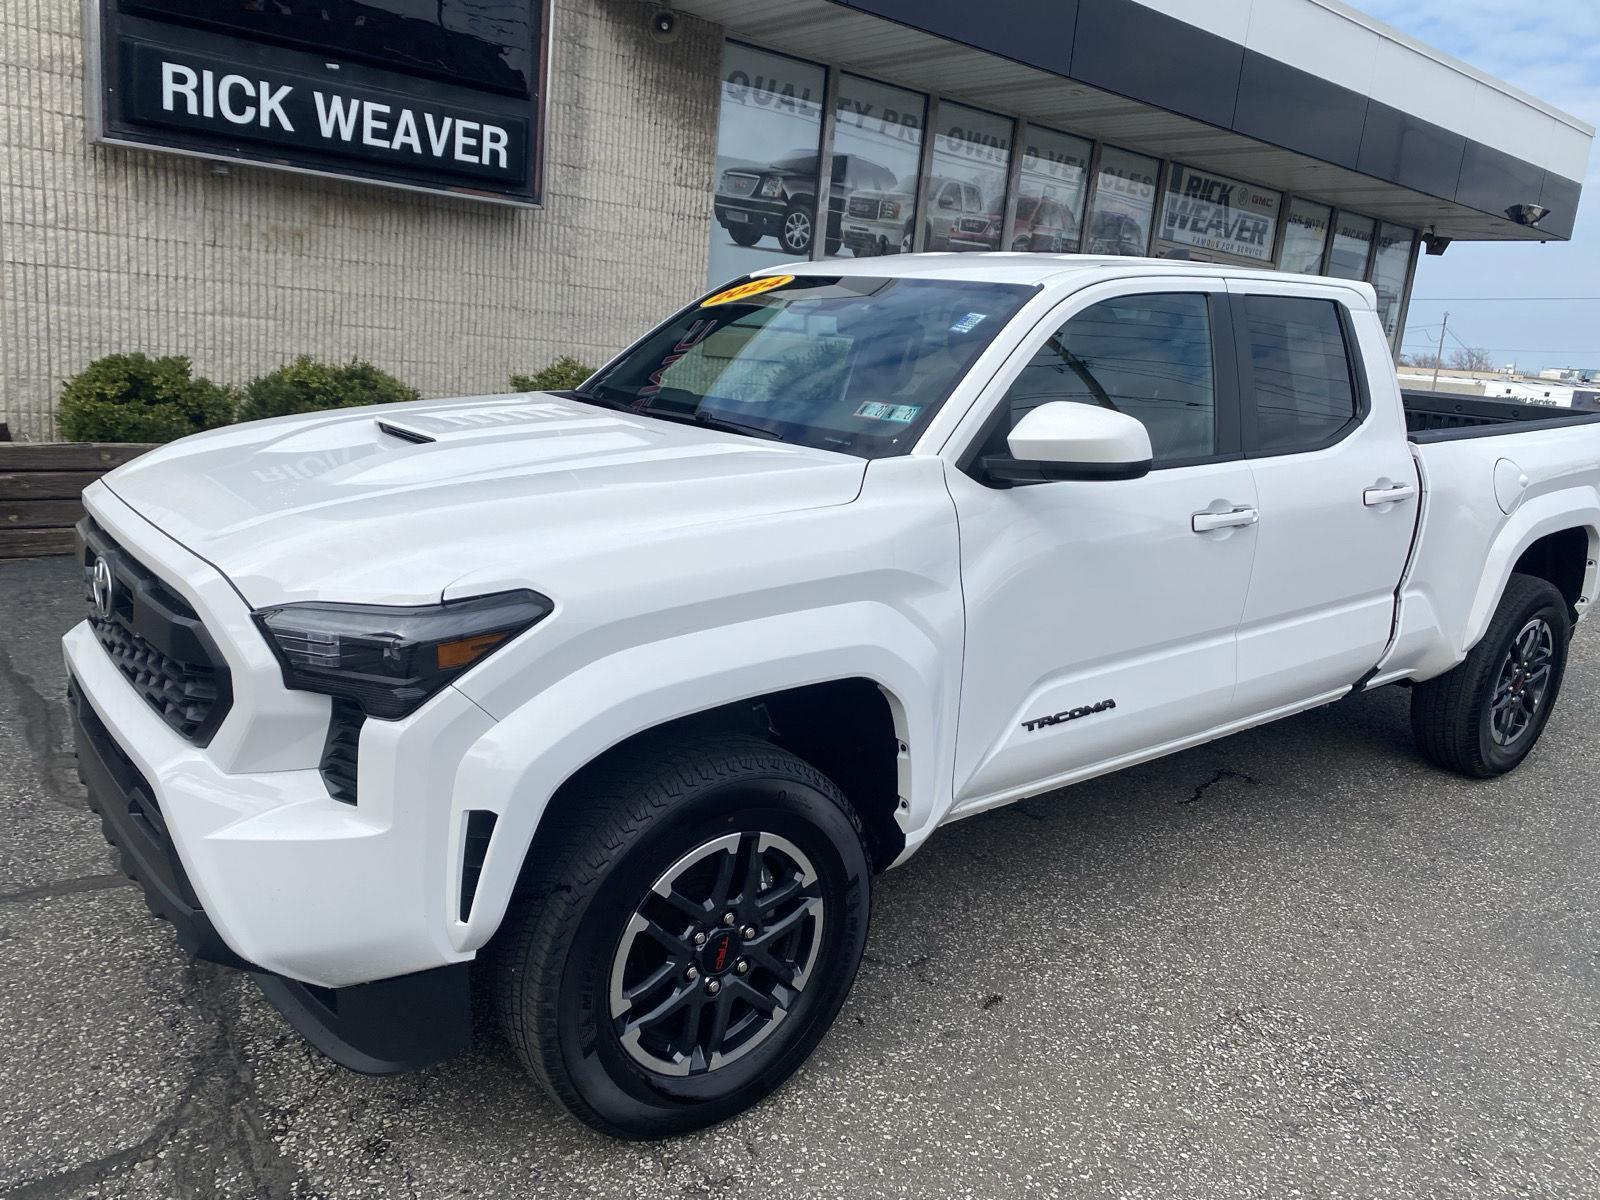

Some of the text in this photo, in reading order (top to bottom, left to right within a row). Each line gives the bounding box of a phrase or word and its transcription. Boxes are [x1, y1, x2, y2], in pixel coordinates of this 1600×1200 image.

[161, 61, 508, 169] RICK WEAVER
[727, 70, 873, 129] QUALTY
[1048, 150, 1154, 198] VECLES
[1183, 174, 1237, 210] RICK
[1251, 193, 1274, 208] GMC
[1167, 196, 1269, 245] WEAVER
[1192, 236, 1264, 257] FAMOUS FOR SERVICE
[1529, 397, 1558, 407] Service
[1021, 698, 1117, 732] TACOMA
[714, 936, 729, 970] TRD
